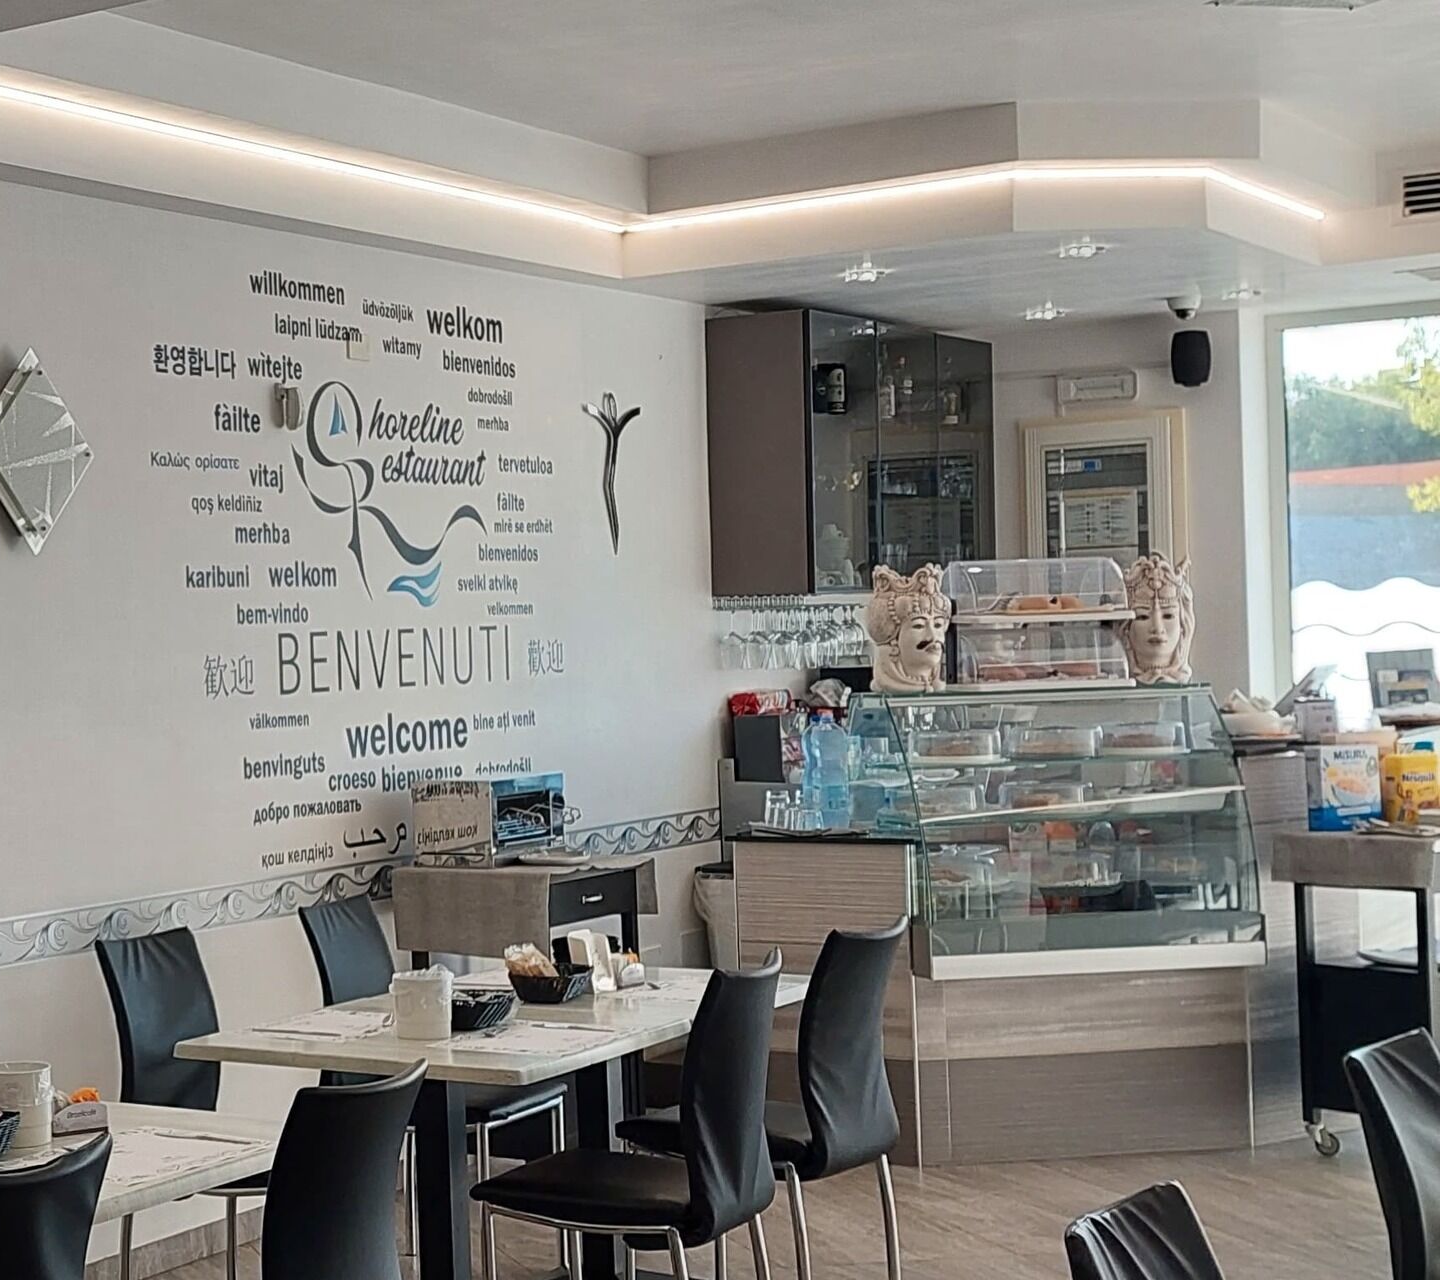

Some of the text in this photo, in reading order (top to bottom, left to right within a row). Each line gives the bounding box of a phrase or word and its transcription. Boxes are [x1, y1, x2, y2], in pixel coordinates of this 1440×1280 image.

[249, 270, 345, 306] willkommen
[274, 312, 363, 344] laipni lūdzam
[426, 305, 503, 344] welkom
[382, 335, 422, 360] witamy
[153, 344, 237, 380] 환영합니다
[442, 349, 516, 379] bienvenidos
[467, 386, 513, 406] dobrodošli
[214, 403, 261, 434] fàilte
[150, 451, 240, 473] Καλώς ορίσατε
[498, 453, 553, 475] tervetuloa
[249, 462, 284, 494] vitaj
[191, 497, 214, 516] qoş
[496, 491, 525, 512] fàilte
[514, 521, 525, 534] se
[478, 543, 539, 562] bienvenidos
[185, 564, 250, 589] karibuni
[268, 560, 337, 588] welkom
[457, 573, 487, 592] sveiki
[236, 601, 309, 625] bem-vindo
[486, 601, 534, 616] velkommen
[277, 624, 511, 696] BENVENUTI
[249, 712, 310, 730] välkommen
[472, 712, 495, 731] bine
[511, 709, 536, 727] venit
[345, 712, 469, 760] welcome
[243, 751, 326, 780] benvinguts
[328, 770, 377, 792] croeso
[253, 798, 362, 827] добро пожаловать
[261, 852, 285, 870] қош
